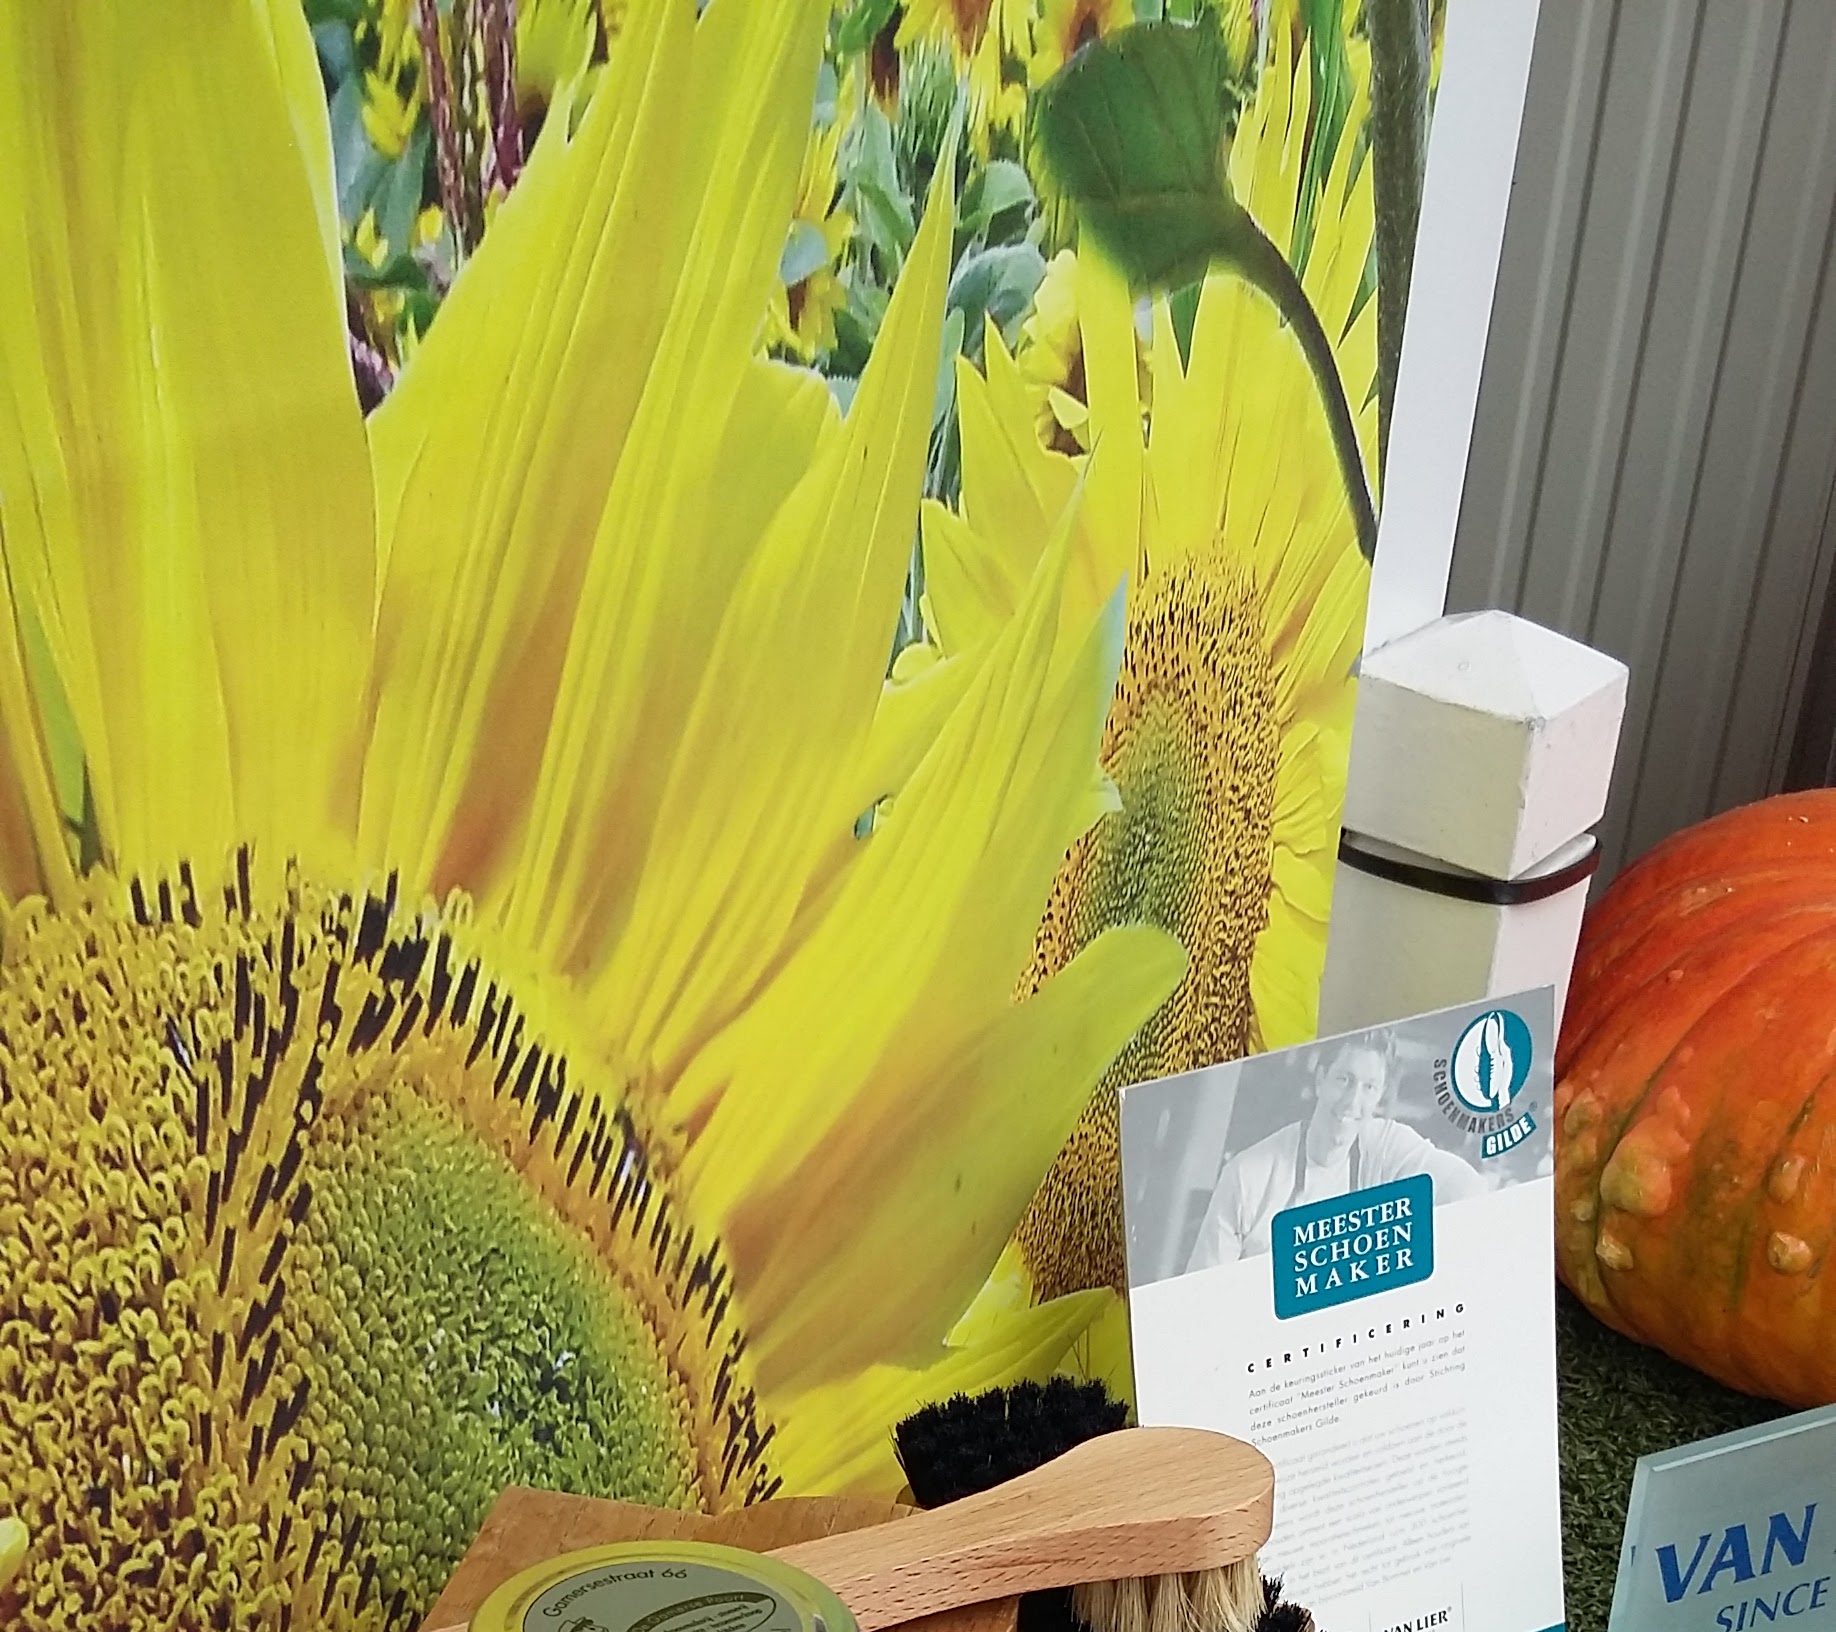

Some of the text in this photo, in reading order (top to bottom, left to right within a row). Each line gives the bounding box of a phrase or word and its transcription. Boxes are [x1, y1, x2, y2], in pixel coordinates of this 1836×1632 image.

[1433, 1058, 1515, 1134] SCHOENMAKERS
[1486, 1115, 1532, 1155] GILDE
[1292, 1197, 1413, 1247] MEESTER
[1294, 1221, 1413, 1272] SCHOEN
[1295, 1248, 1414, 1298] MAKER
[1247, 1303, 1464, 1373] CERTIFICERING
[1249, 1388, 1266, 1399] Aan
[1270, 1383, 1281, 1393] de
[1284, 1365, 1347, 1388] keuringssticker
[1350, 1360, 1365, 1369] van
[1368, 1354, 1382, 1363] het
[1384, 1344, 1415, 1359] huidige
[1438, 1336, 1449, 1347] op
[1452, 1330, 1465, 1339] het
[1249, 1396, 1294, 1415] certificaat
[1402, 1358, 1420, 1370] kunt
[1431, 1352, 1449, 1362] zien
[1452, 1346, 1465, 1356] dat
[1250, 1419, 1272, 1432] deze
[1277, 1398, 1348, 1424] schoenhersteller
[1353, 1384, 1388, 1404] gekeurd
[1404, 1374, 1425, 1387] door
[1429, 1362, 1465, 1379] Stichting
[1251, 1422, 1312, 1447] Schoenmakers
[1655, 1502, 1819, 1604] VAN
[543, 1568, 688, 1618] Gamersestraat 66
[1416, 1610, 1448, 1631] LIER
